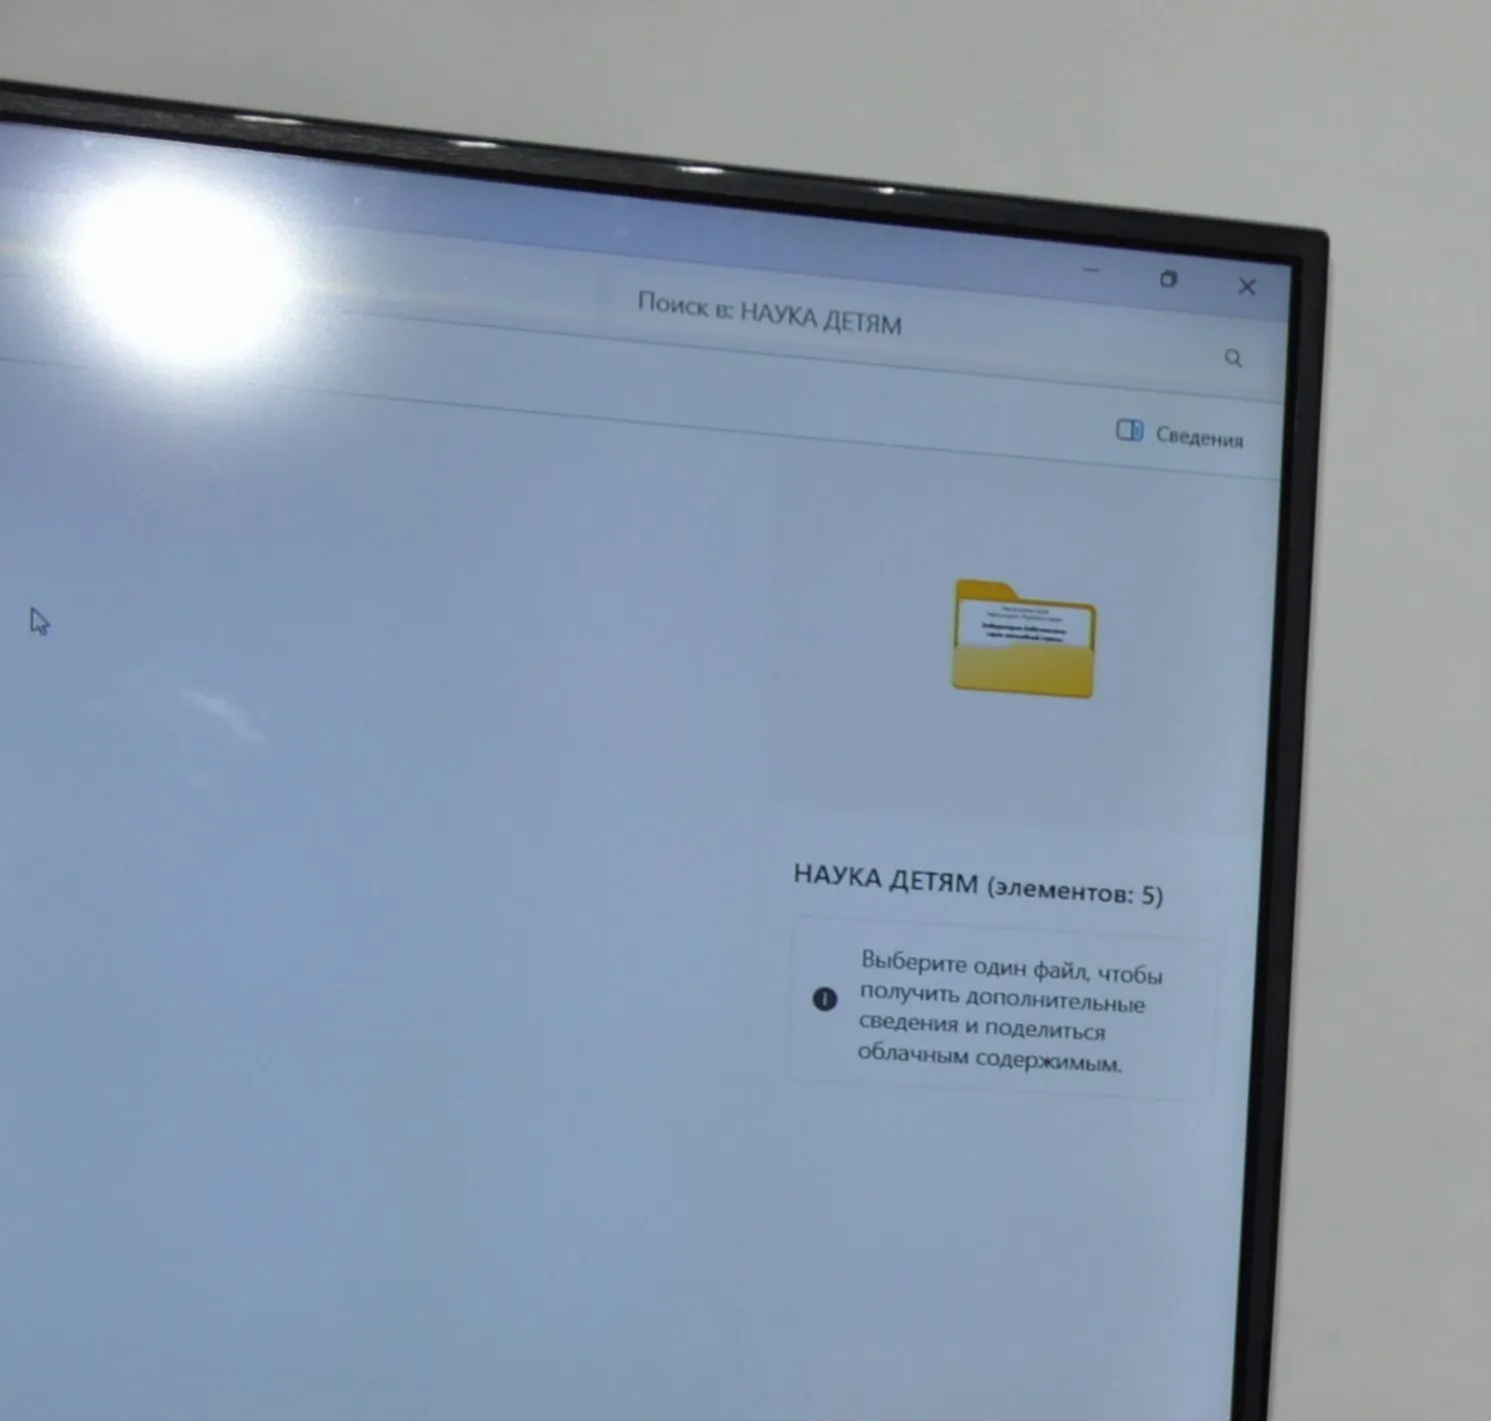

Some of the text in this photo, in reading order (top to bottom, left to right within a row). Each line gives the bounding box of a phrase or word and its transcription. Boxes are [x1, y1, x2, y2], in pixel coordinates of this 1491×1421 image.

[639, 290, 902, 337] Поиск в: НАУКА ДЕТЯМ
[1156, 425, 1244, 450] Сведения
[794, 862, 1164, 909] НАУКА ДЕТЯМ (элементов: 5)
[862, 949, 1163, 986] Выберите один файл, чтобы
[860, 983, 1146, 1014] получить дополнительные
[859, 1013, 1106, 1042] сведения и поделиться
[858, 1041, 1122, 1075] облачным содержимым.
